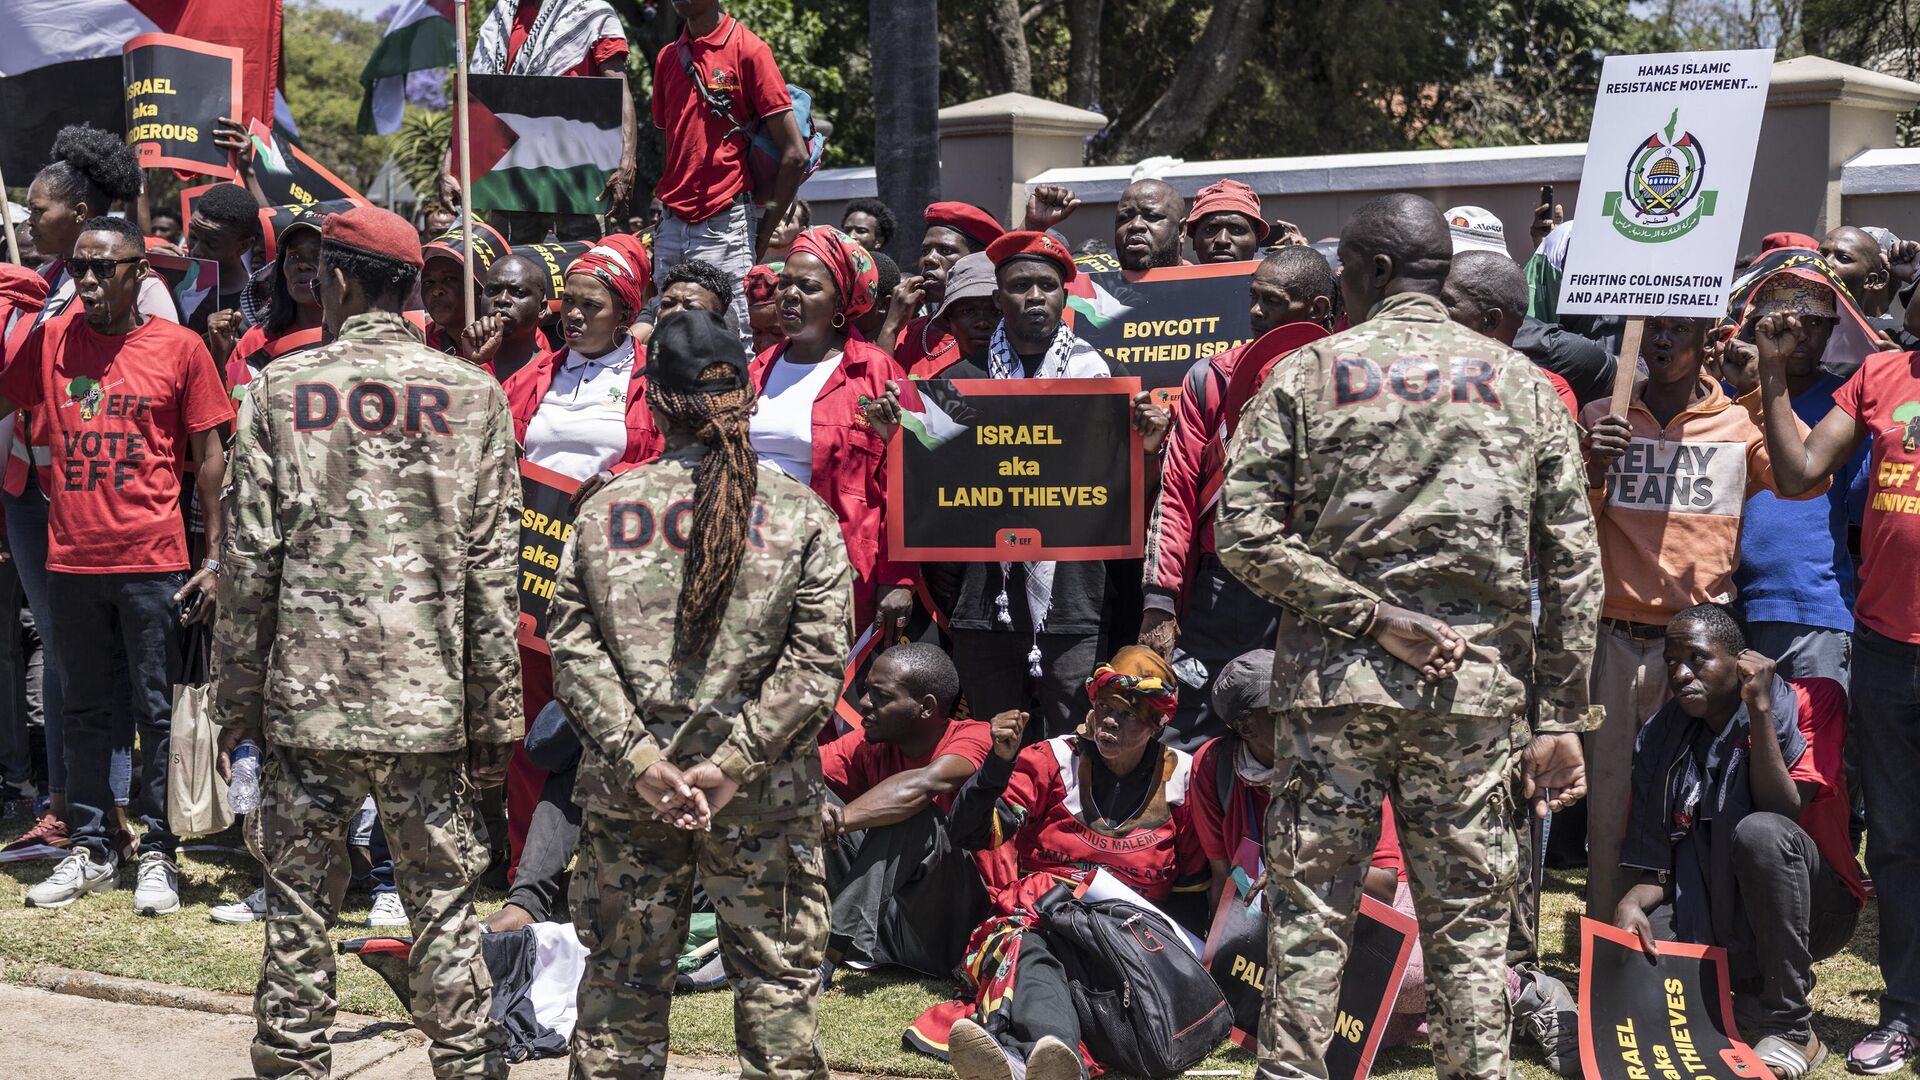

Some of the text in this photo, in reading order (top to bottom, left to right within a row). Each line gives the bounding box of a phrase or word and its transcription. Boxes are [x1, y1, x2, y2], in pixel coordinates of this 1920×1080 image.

[1638, 62, 1731, 77] HAMAS ISLAMIC
[1606, 78, 1758, 94] RESISTANCE MOVEMENT...
[132, 102, 158, 119] aka
[127, 123, 199, 144] RDEROUS
[1569, 274, 1723, 288] FIGHTING COLONISATION
[1566, 292, 1720, 306] AND APARTHEID ISRAEL!
[1123, 316, 1220, 339] BOYCOTT
[1103, 344, 1190, 363] ARTHEID
[1333, 356, 1503, 409] DOR
[106, 394, 152, 418] EFF
[293, 381, 454, 437] DOR
[63, 430, 146, 460] VOTE
[976, 425, 1062, 445] ISRAEL
[64, 459, 140, 492] EFF
[998, 456, 1040, 476] aka
[1879, 461, 1915, 489] EFF
[938, 486, 1108, 507] LAND THIEVES
[1871, 492, 1920, 516] ANNIVE
[521, 508, 574, 543] SRAE
[1019, 537, 1032, 545] EFF
[522, 545, 559, 570] aka
[1112, 832, 1162, 851] MALEMA
[1664, 978, 1707, 1074] THIEVES
[1616, 1017, 1650, 1080] RAEL
[1652, 1044, 1682, 1080] aka
